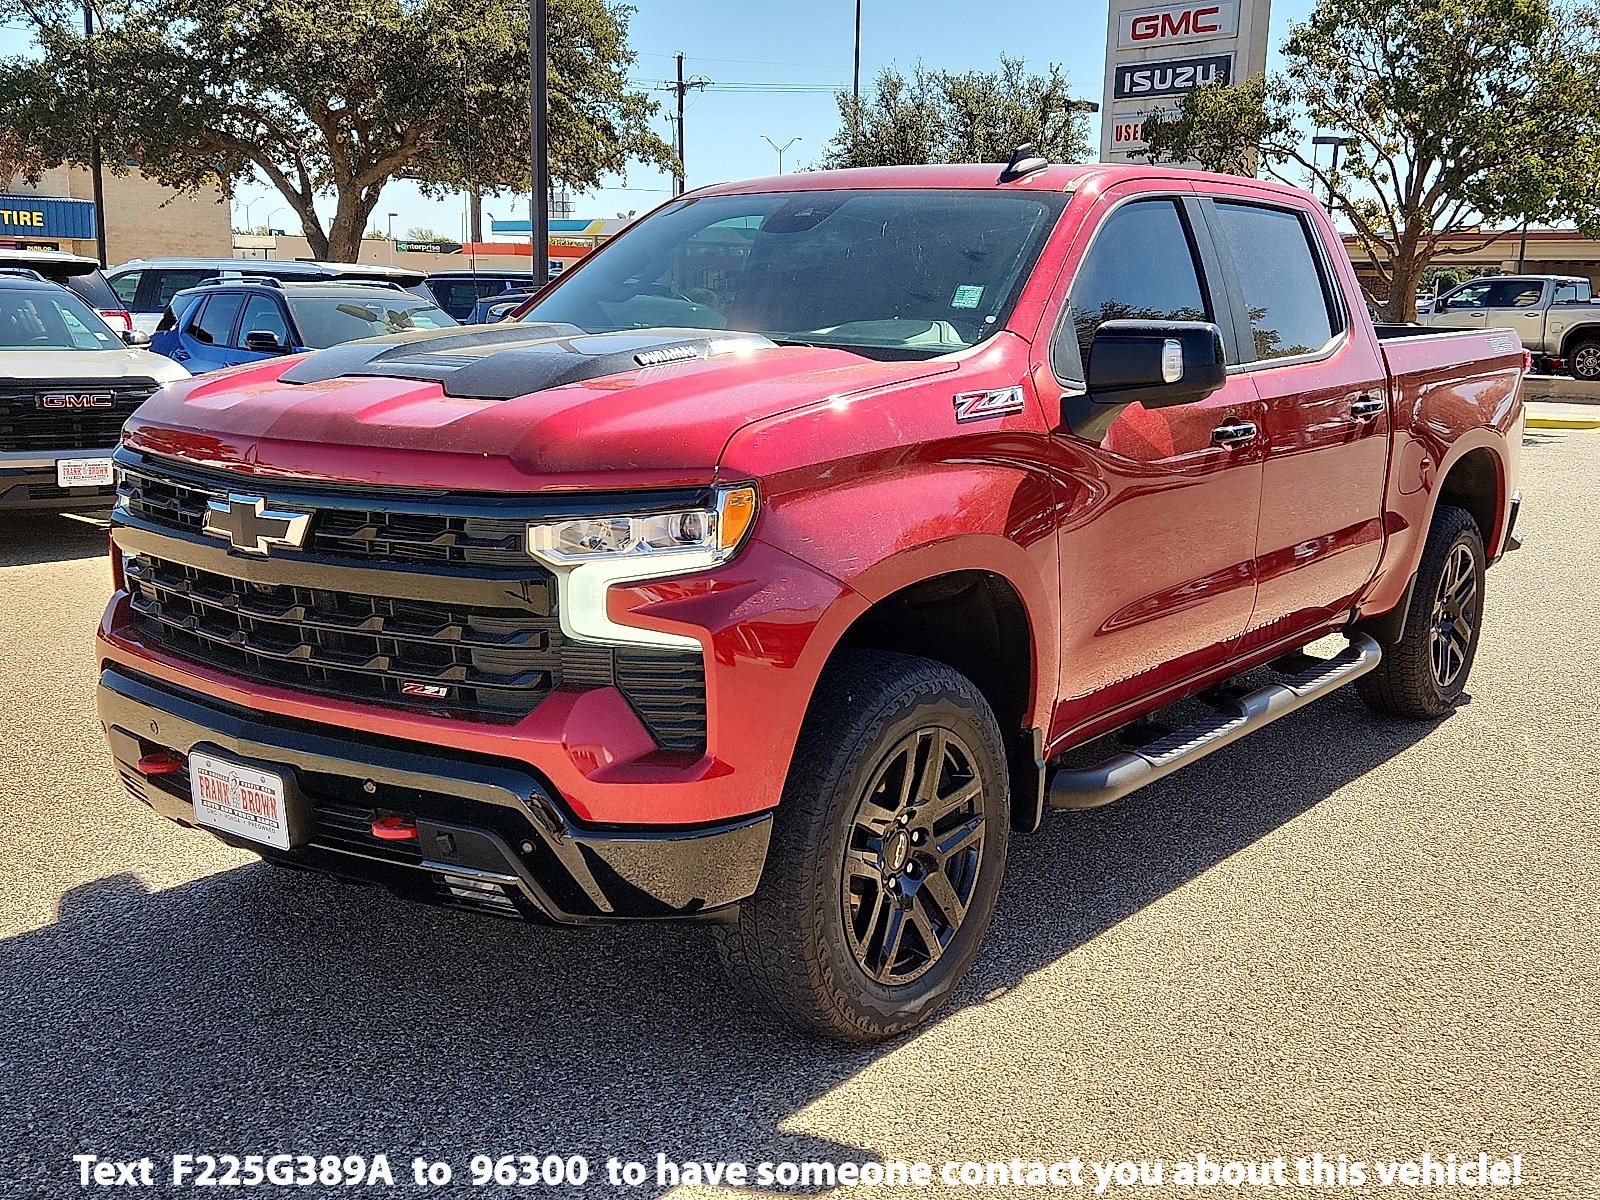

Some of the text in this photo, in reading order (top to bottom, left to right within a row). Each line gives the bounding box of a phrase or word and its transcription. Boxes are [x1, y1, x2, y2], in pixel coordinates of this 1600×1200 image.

[1131, 6, 1219, 41] GMC
[1124, 63, 1217, 93] ISUZU
[0, 210, 44, 227] TIRE
[398, 243, 441, 252] enterprise
[43, 394, 112, 408] GMC
[63, 466, 108, 476] FRANK BROWN
[198, 775, 230, 804] FRANK
[240, 788, 278, 820] BROWN
[203, 800, 220, 810] AUTO
[221, 805, 233, 814] AND
[235, 809, 255, 820] TRUCK
